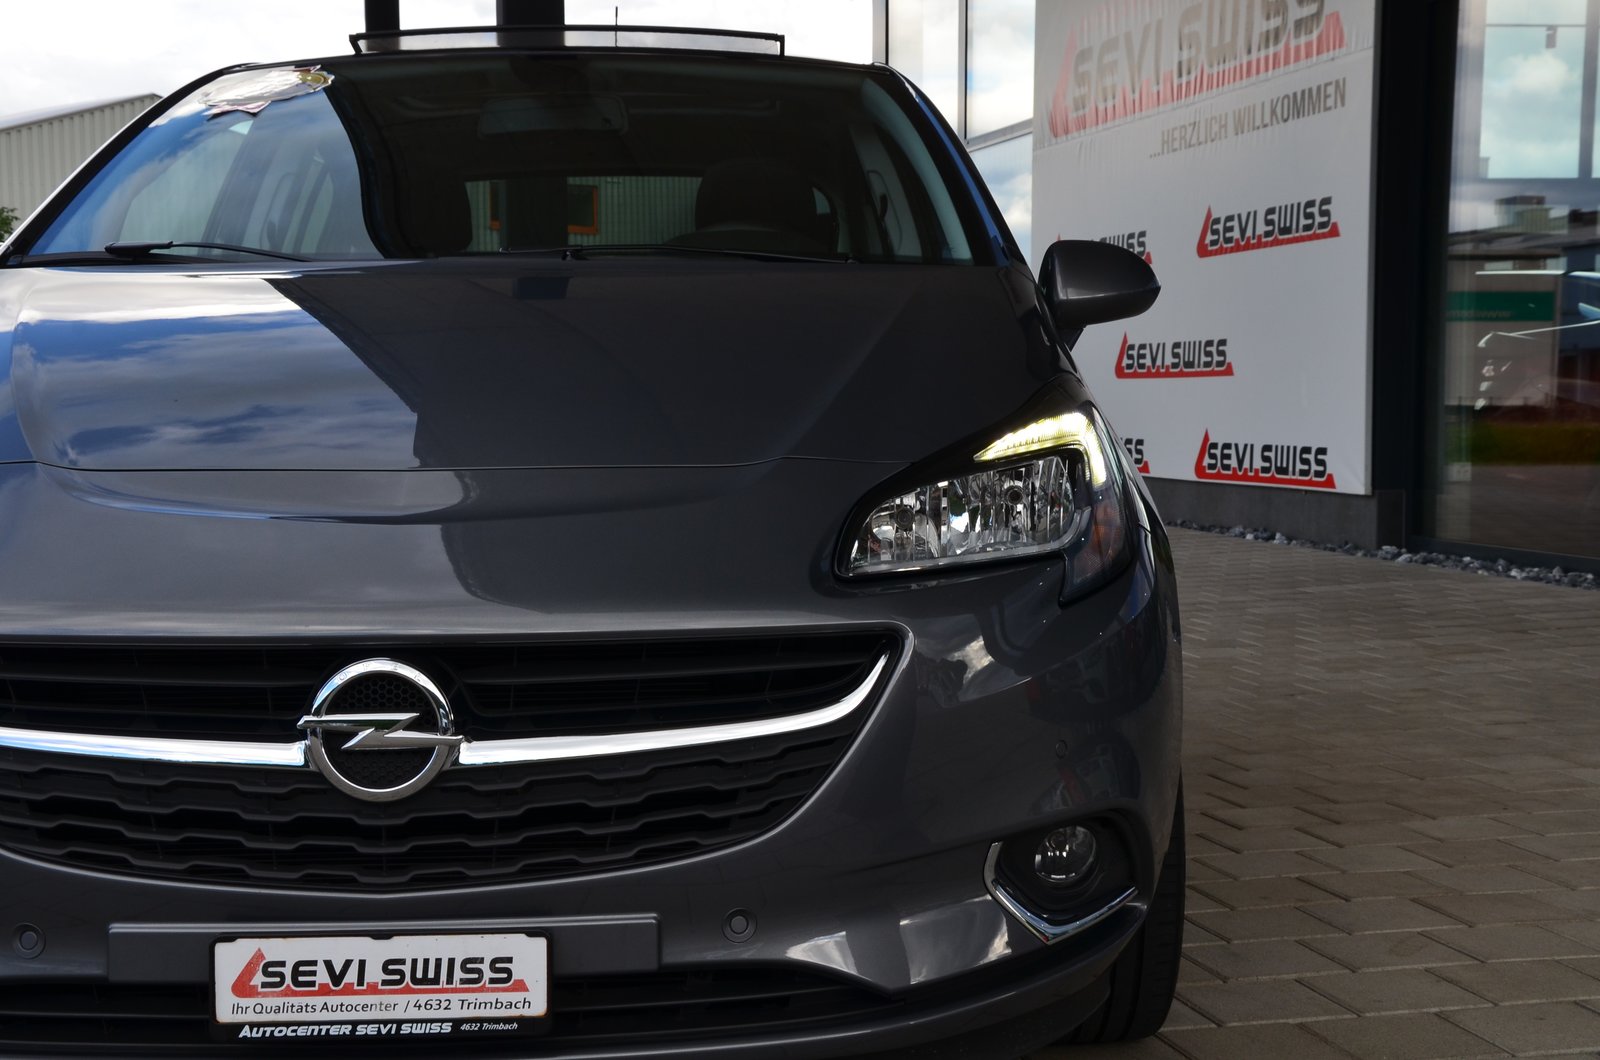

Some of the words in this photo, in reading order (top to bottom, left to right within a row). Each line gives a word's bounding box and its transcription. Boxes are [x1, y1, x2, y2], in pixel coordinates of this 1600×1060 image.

[1071, 17, 1164, 114] SEVI
[1232, 77, 1347, 137] WILLKOMMEN
[1209, 209, 1258, 248] SEVI
[1263, 196, 1333, 240] SWISS
[1125, 342, 1166, 371] SEVI
[1171, 338, 1228, 370] SWISS
[1206, 442, 1254, 474] SEVI
[1260, 444, 1328, 479] SWISS
[260, 958, 367, 990] SEVI
[380, 956, 514, 988] SWISS
[231, 1002, 250, 1015] Ihr
[253, 1001, 317, 1015] Qualitäts
[319, 1001, 399, 1014] Autocenter
[413, 999, 452, 1012] 4632
[458, 997, 532, 1011] Trimbach
[238, 1024, 353, 1038] AUTOCENTER
[355, 1023, 397, 1036] SEVI
[400, 1022, 453, 1035] SWISS
[460, 1022, 480, 1031] 4632
[482, 1021, 518, 1031] Trimbach
